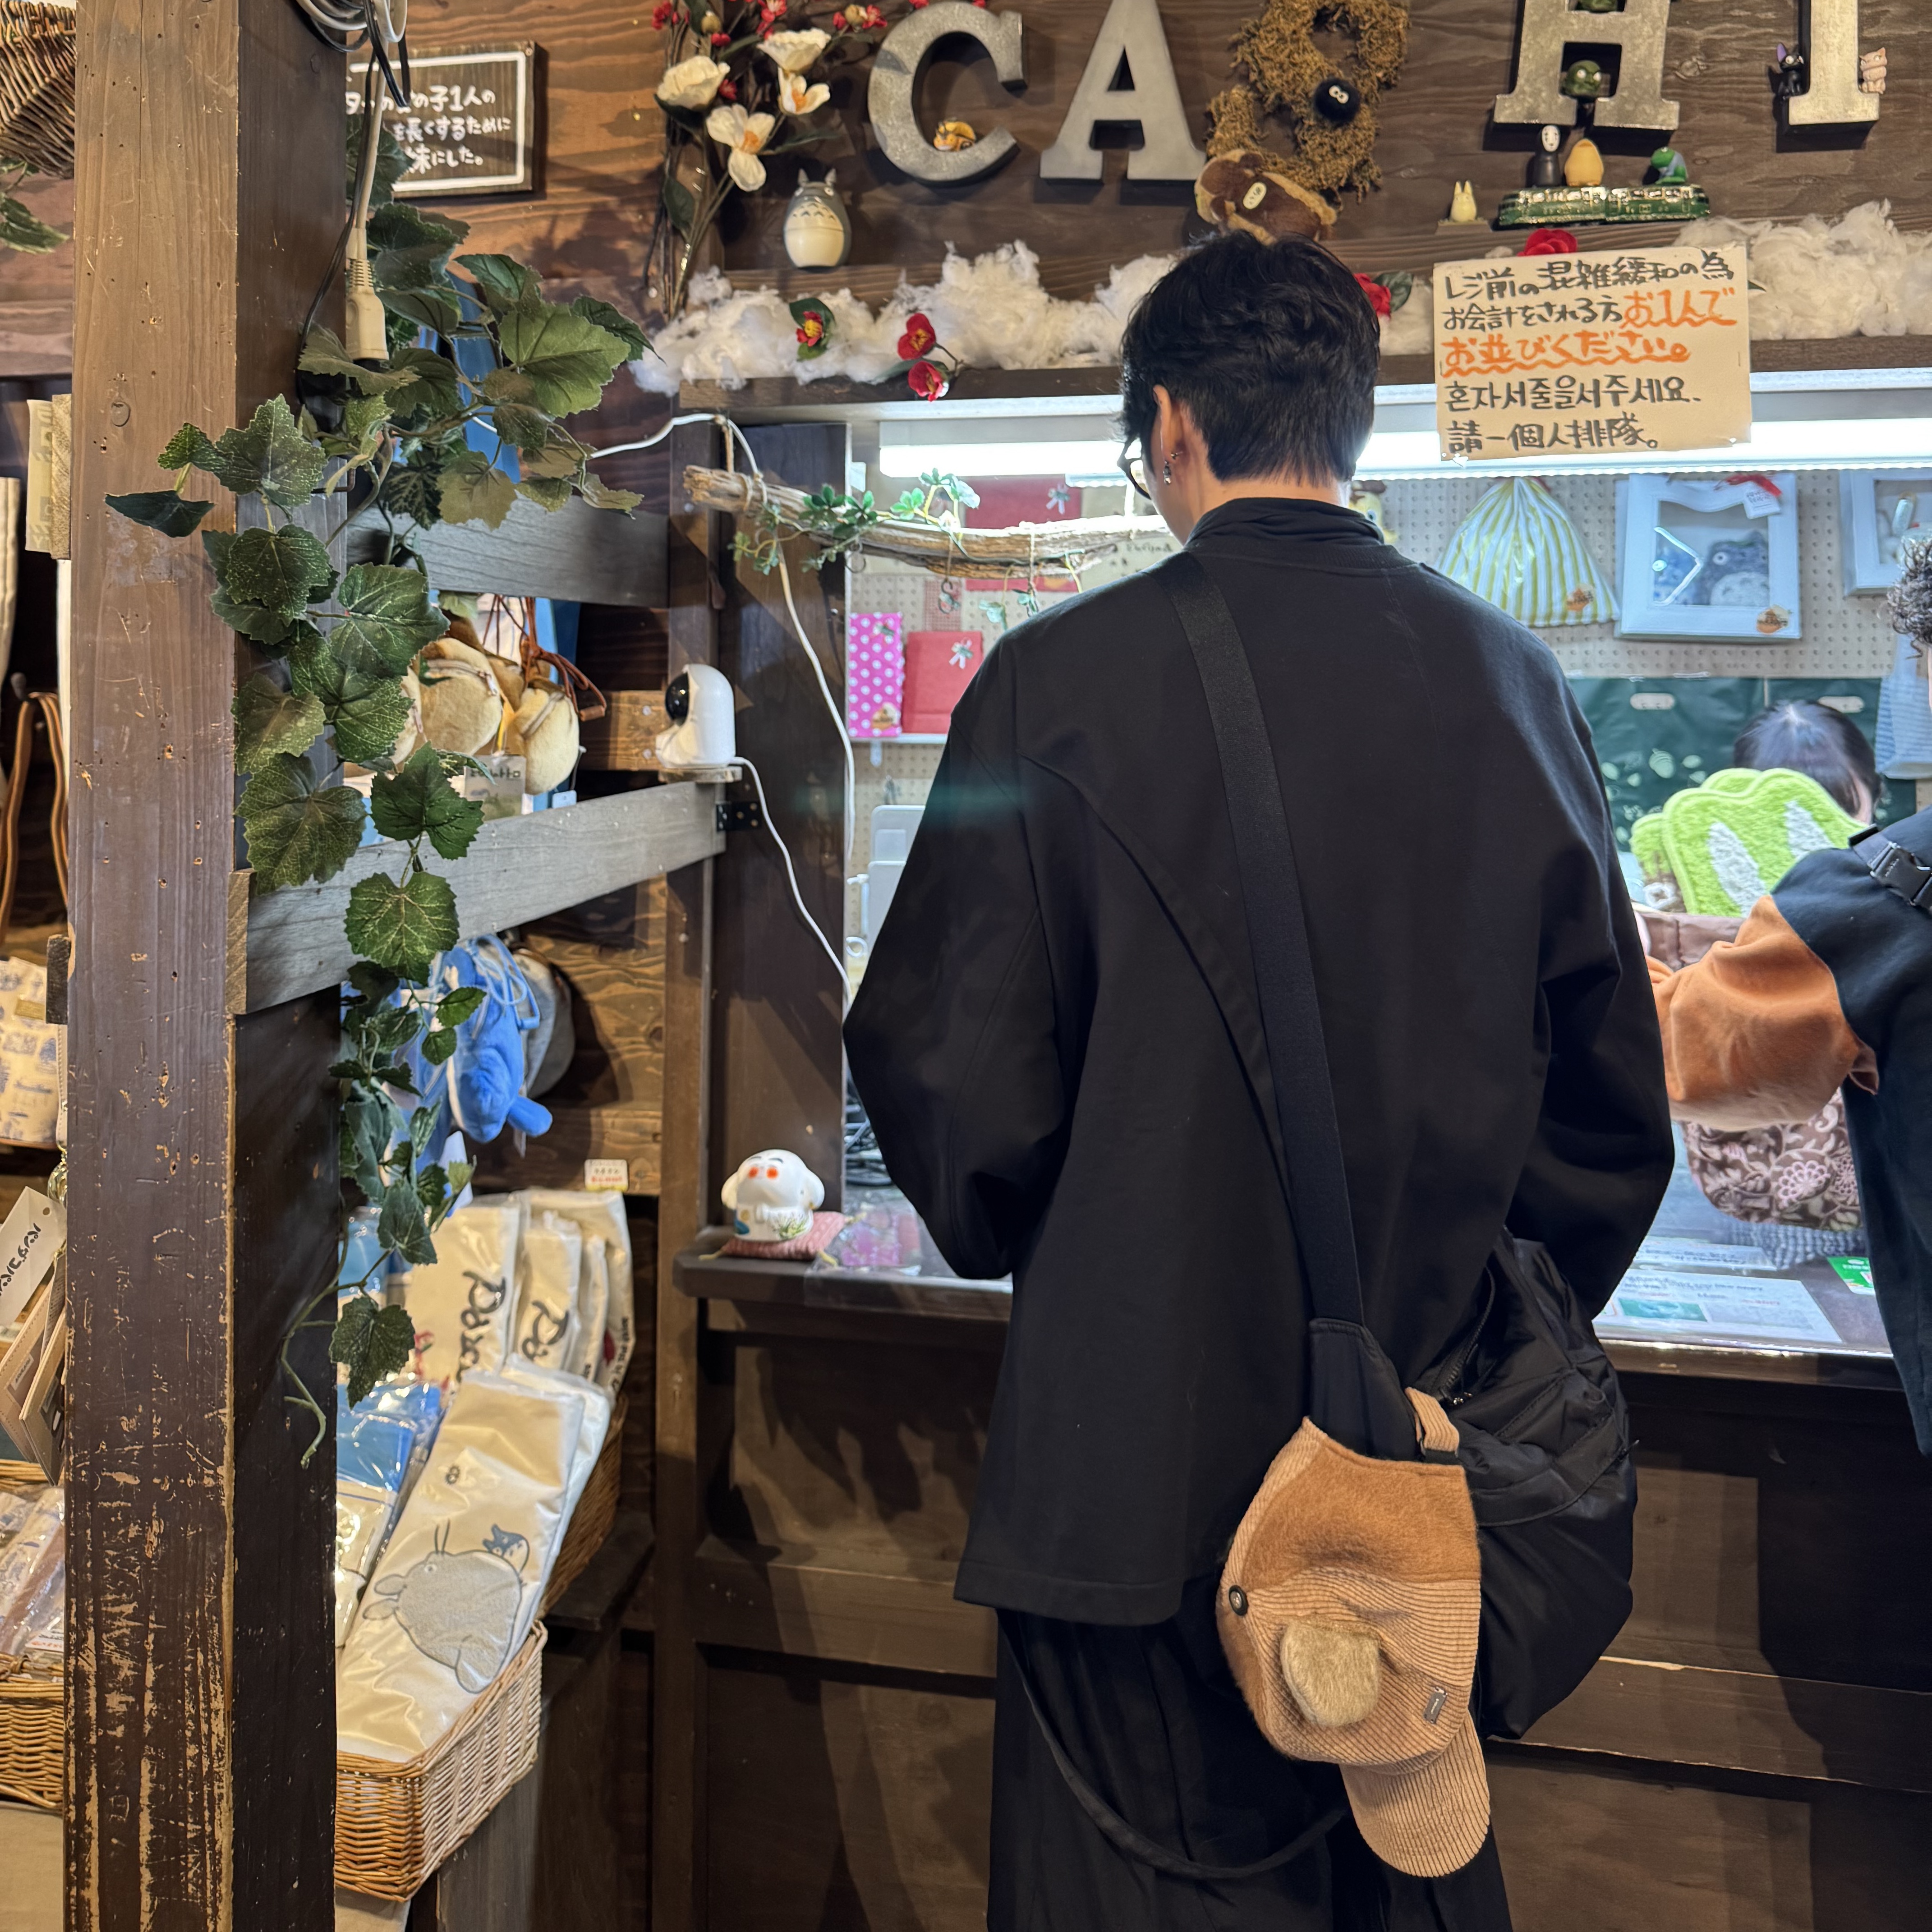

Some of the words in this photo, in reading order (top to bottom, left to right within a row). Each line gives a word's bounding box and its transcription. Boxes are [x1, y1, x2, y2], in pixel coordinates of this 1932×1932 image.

[1442, 330, 1690, 363] お並びください。
[0, 1223, 41, 1296] パンダコパン
